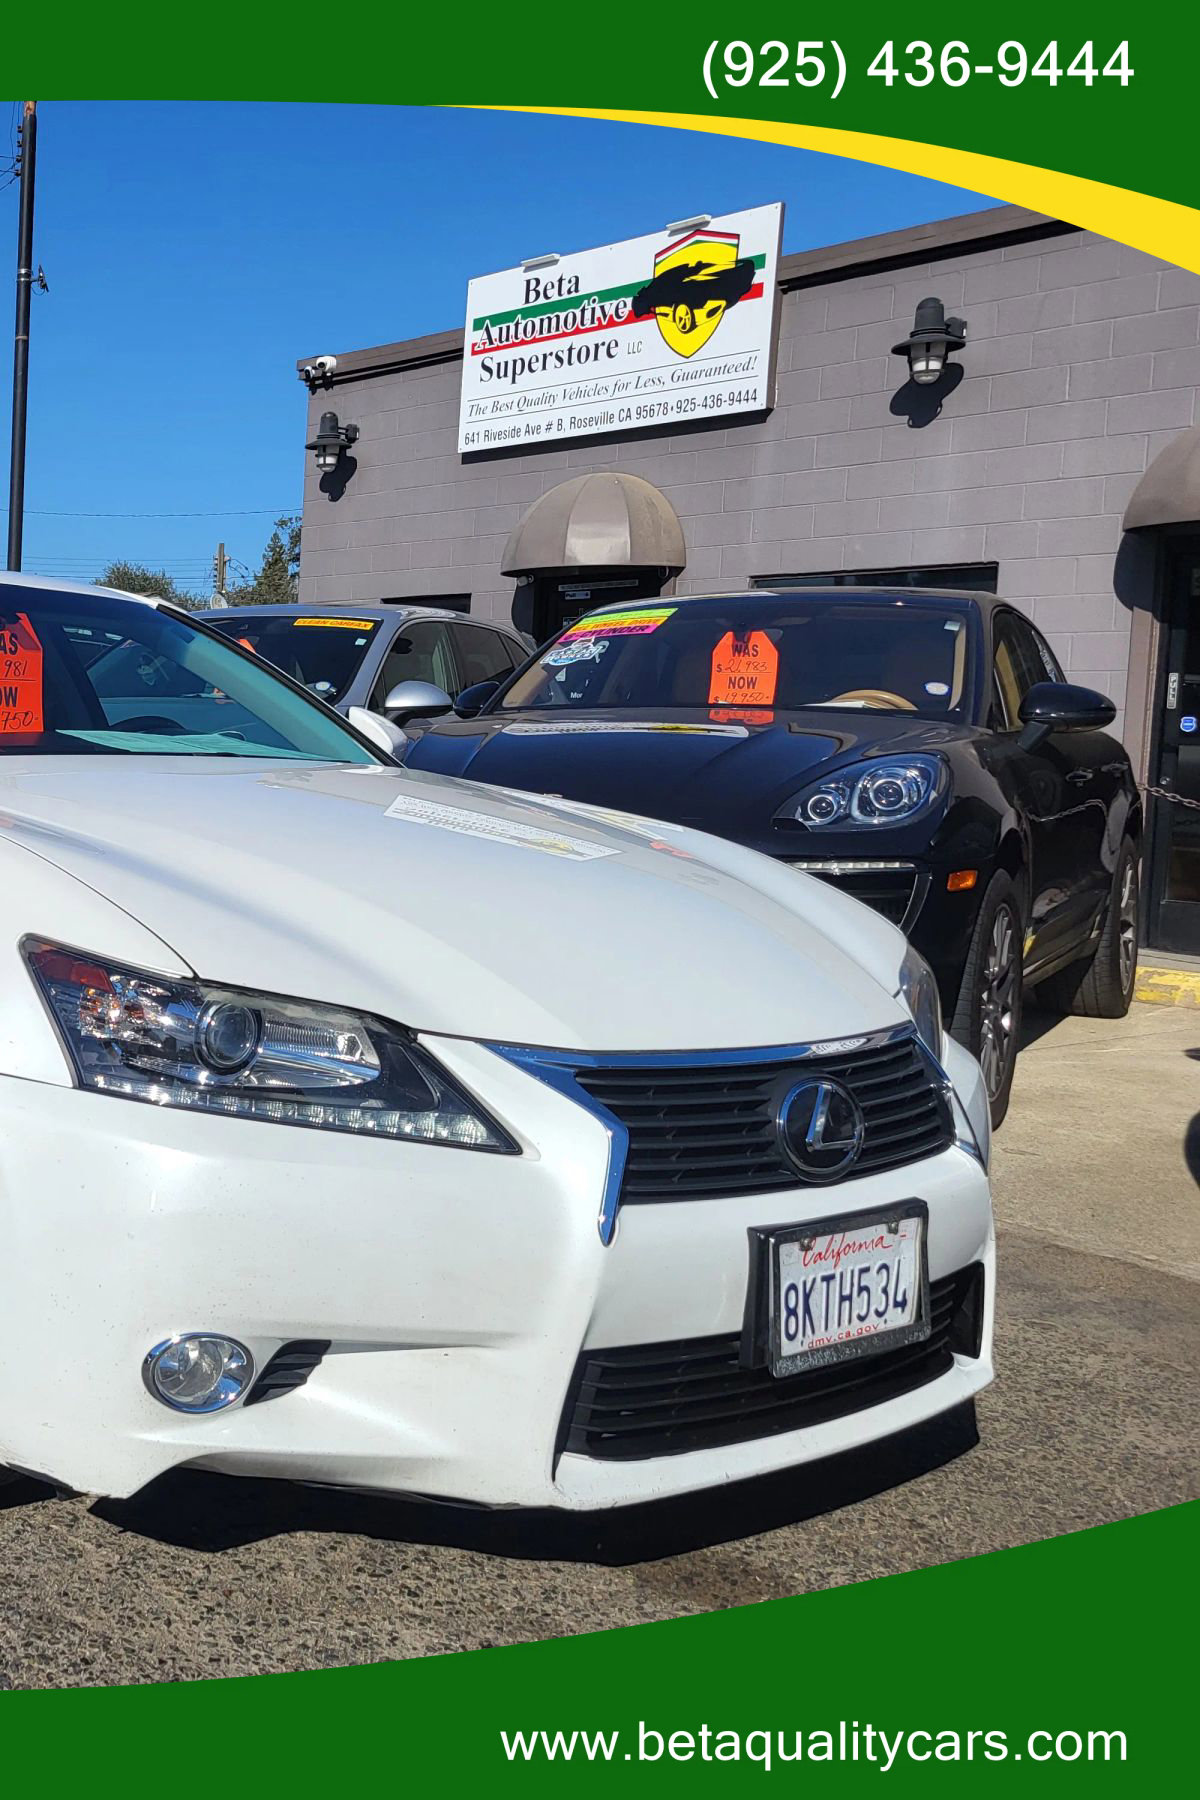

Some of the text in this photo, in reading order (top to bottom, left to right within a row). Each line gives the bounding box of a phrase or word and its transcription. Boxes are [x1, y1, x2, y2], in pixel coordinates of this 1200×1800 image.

[522, 272, 580, 305] Beta
[477, 298, 627, 349] Automotive
[480, 338, 642, 385] Superstore LLC
[468, 356, 757, 417] The Best Quality Vehicles for Less, Guaranteed!
[464, 432, 480, 445] 641
[484, 426, 521, 443] Riveside
[524, 423, 541, 436] Ave
[569, 412, 614, 430] Roseville
[618, 408, 631, 422] CA
[732, 644, 759, 657] WAS
[728, 676, 758, 690] NOW
[802, 1232, 893, 1268] California
[784, 1258, 908, 1342] 8KTH534
[807, 1323, 880, 1349] dmv.ca.gov
